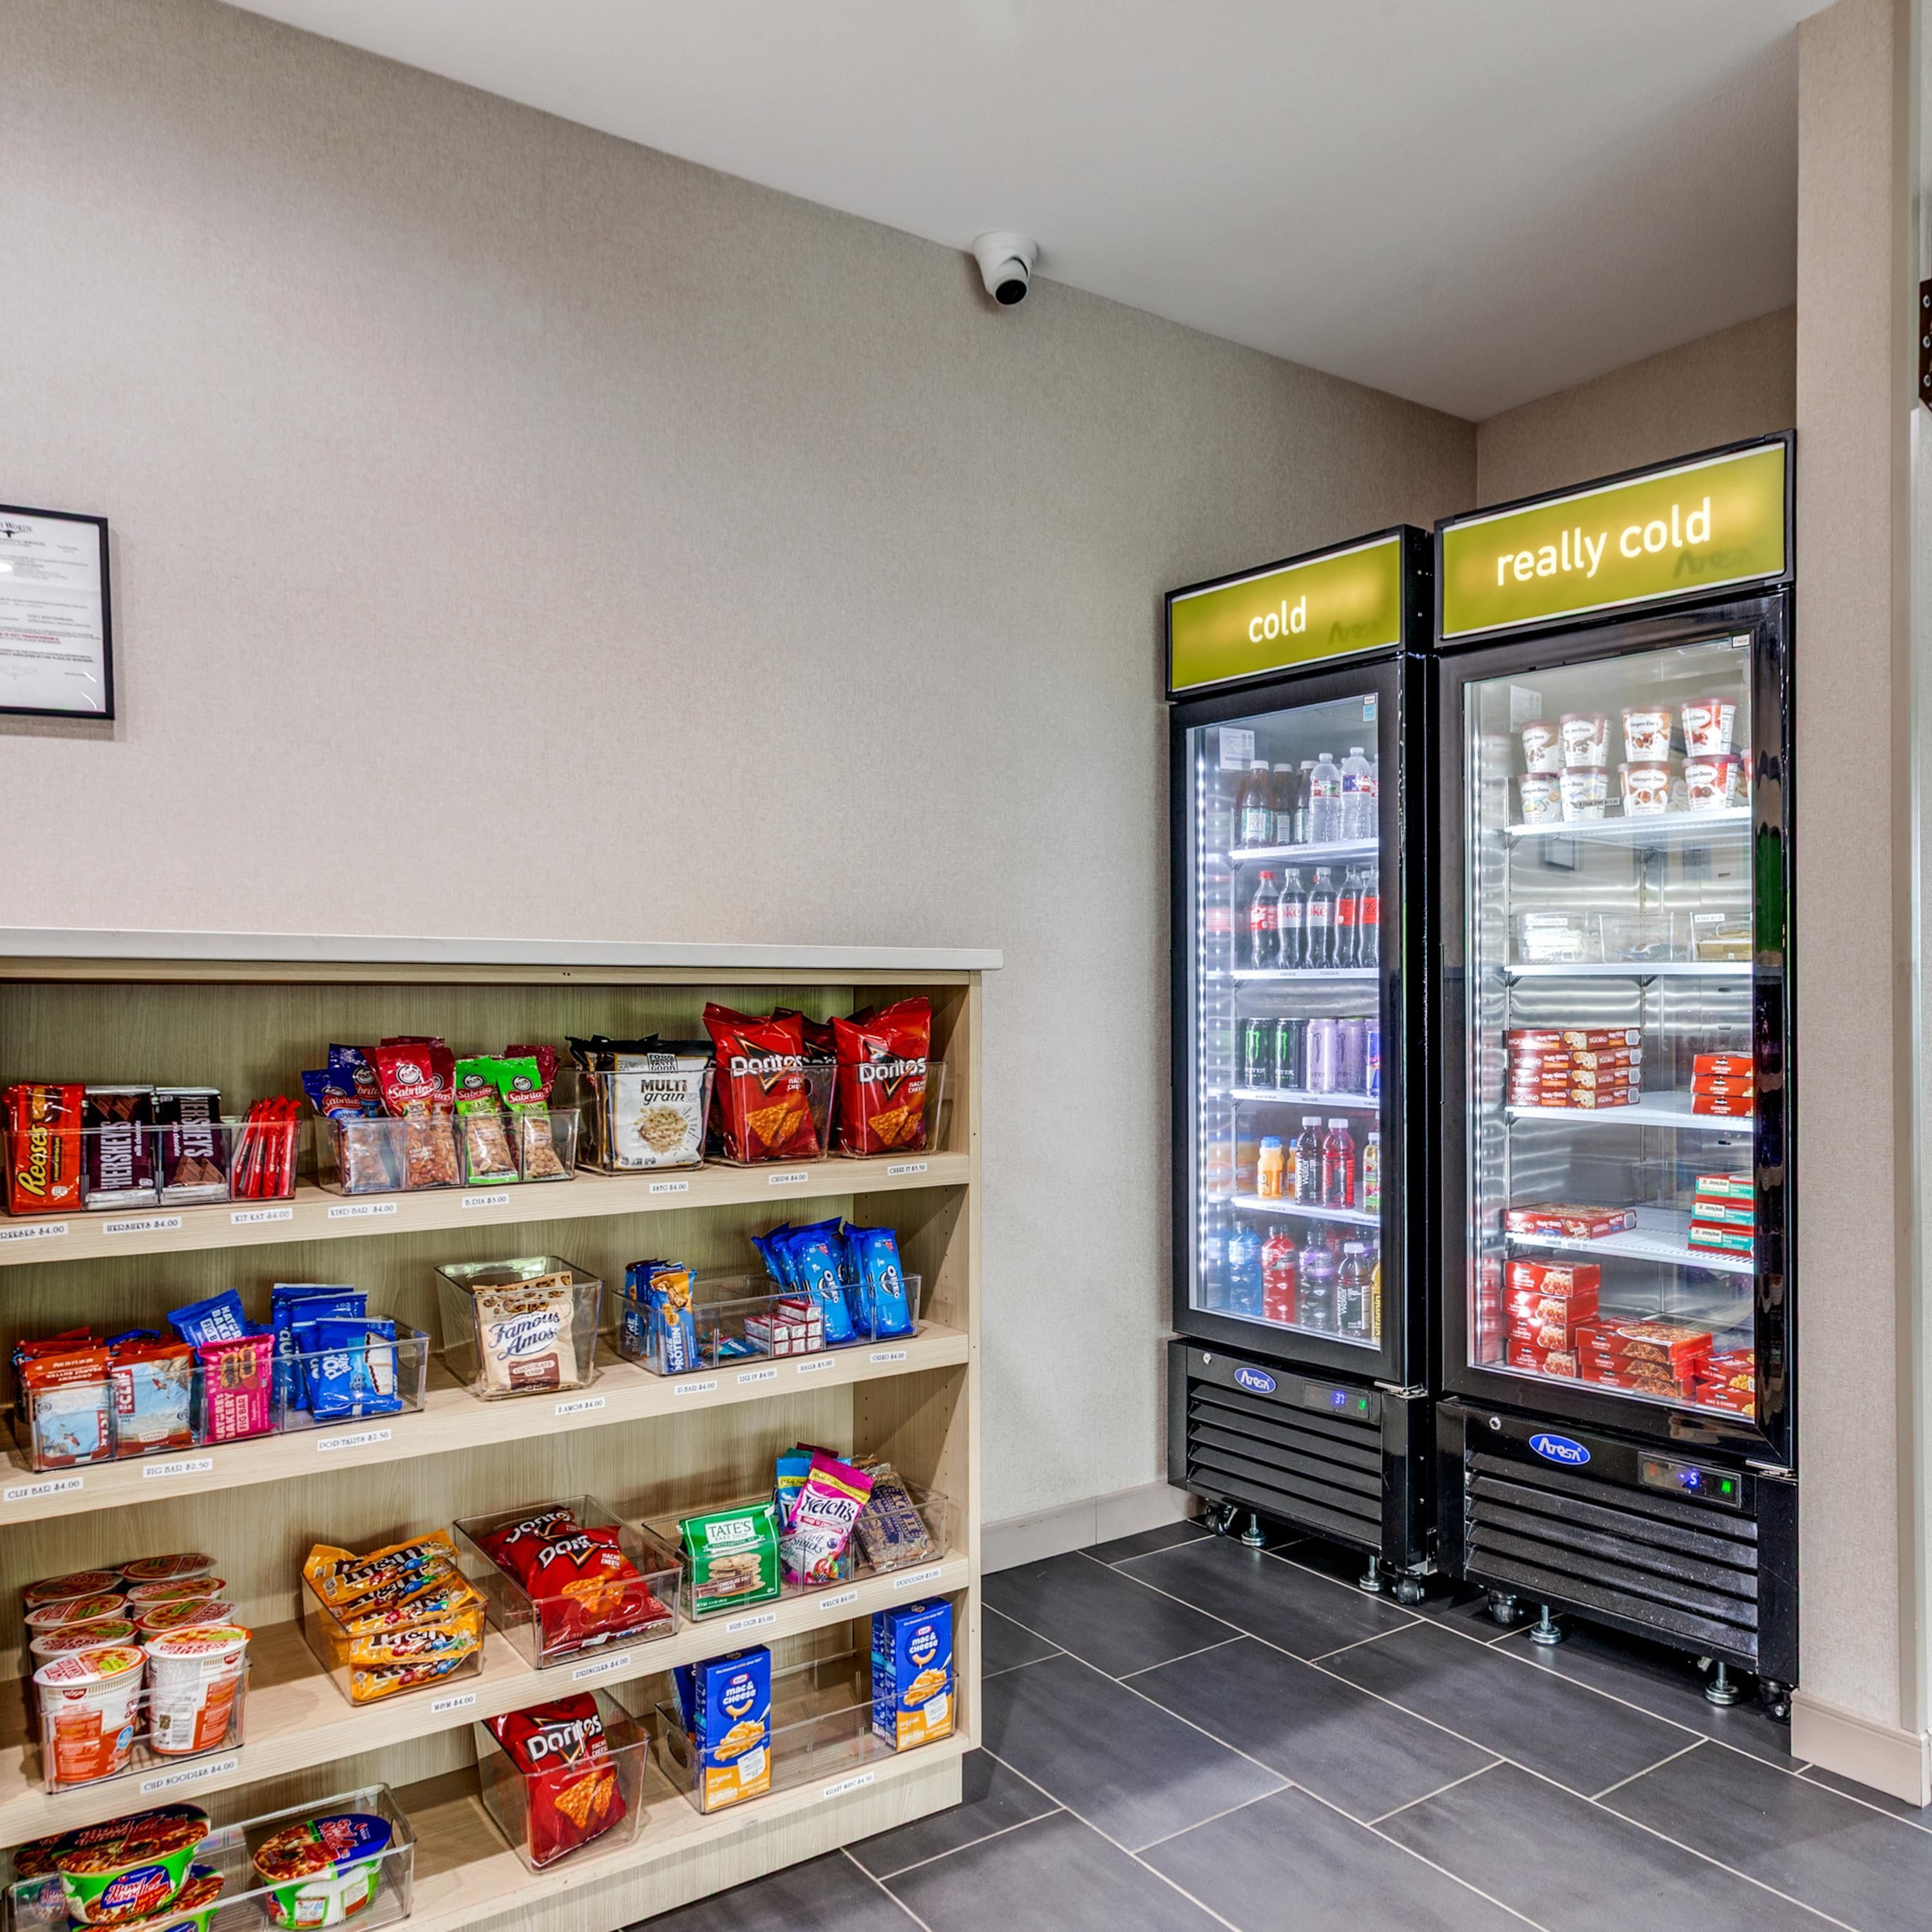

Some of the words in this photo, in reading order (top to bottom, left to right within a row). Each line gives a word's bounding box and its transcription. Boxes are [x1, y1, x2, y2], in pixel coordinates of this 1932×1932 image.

[1497, 531, 1607, 586] really
[1619, 497, 1712, 559] cold
[1247, 595, 1307, 643] cold
[731, 1054, 804, 1077] Doritos
[859, 1057, 927, 1083] Doritos
[392, 1084, 433, 1098] Sabritas
[641, 1079, 688, 1094] MULTI
[643, 1092, 685, 1106] grain
[235, 1213, 249, 1222] KIT
[250, 1212, 265, 1221] KAT
[267, 1210, 290, 1219] $4.00
[330, 1208, 350, 1217] KIND
[352, 1207, 368, 1215] BAR
[372, 1204, 395, 1214] $4.00
[39, 1226, 65, 1235] $4.00
[154, 1220, 178, 1229] $4.00
[887, 1264, 900, 1299] OREO
[488, 1312, 560, 1349] Famous
[497, 1327, 558, 1361] Amos
[515, 1361, 553, 1374] CHOCOLATE
[759, 1370, 775, 1379] $4.00
[699, 1382, 715, 1390] $4.00
[585, 1399, 603, 1409] $4.00
[1335, 1393, 1345, 1405] 37
[225, 1392, 235, 1438] BAKERY
[146, 1467, 162, 1476] FIG
[164, 1464, 182, 1474] BAR
[185, 1461, 209, 1472] $2.50
[8, 1488, 28, 1499] CLIF
[32, 1486, 52, 1495] BAR
[54, 1480, 80, 1492] $4.00
[801, 1494, 855, 1522] Welch's
[708, 1520, 752, 1538] TATE'S
[840, 1593, 856, 1603] $4.00
[611, 1658, 629, 1669] $4.00
[453, 1695, 474, 1707] $4.00
[527, 1714, 602, 1761] Doritos
[144, 1780, 164, 1790] CUP
[211, 1761, 234, 1774] $4.00
